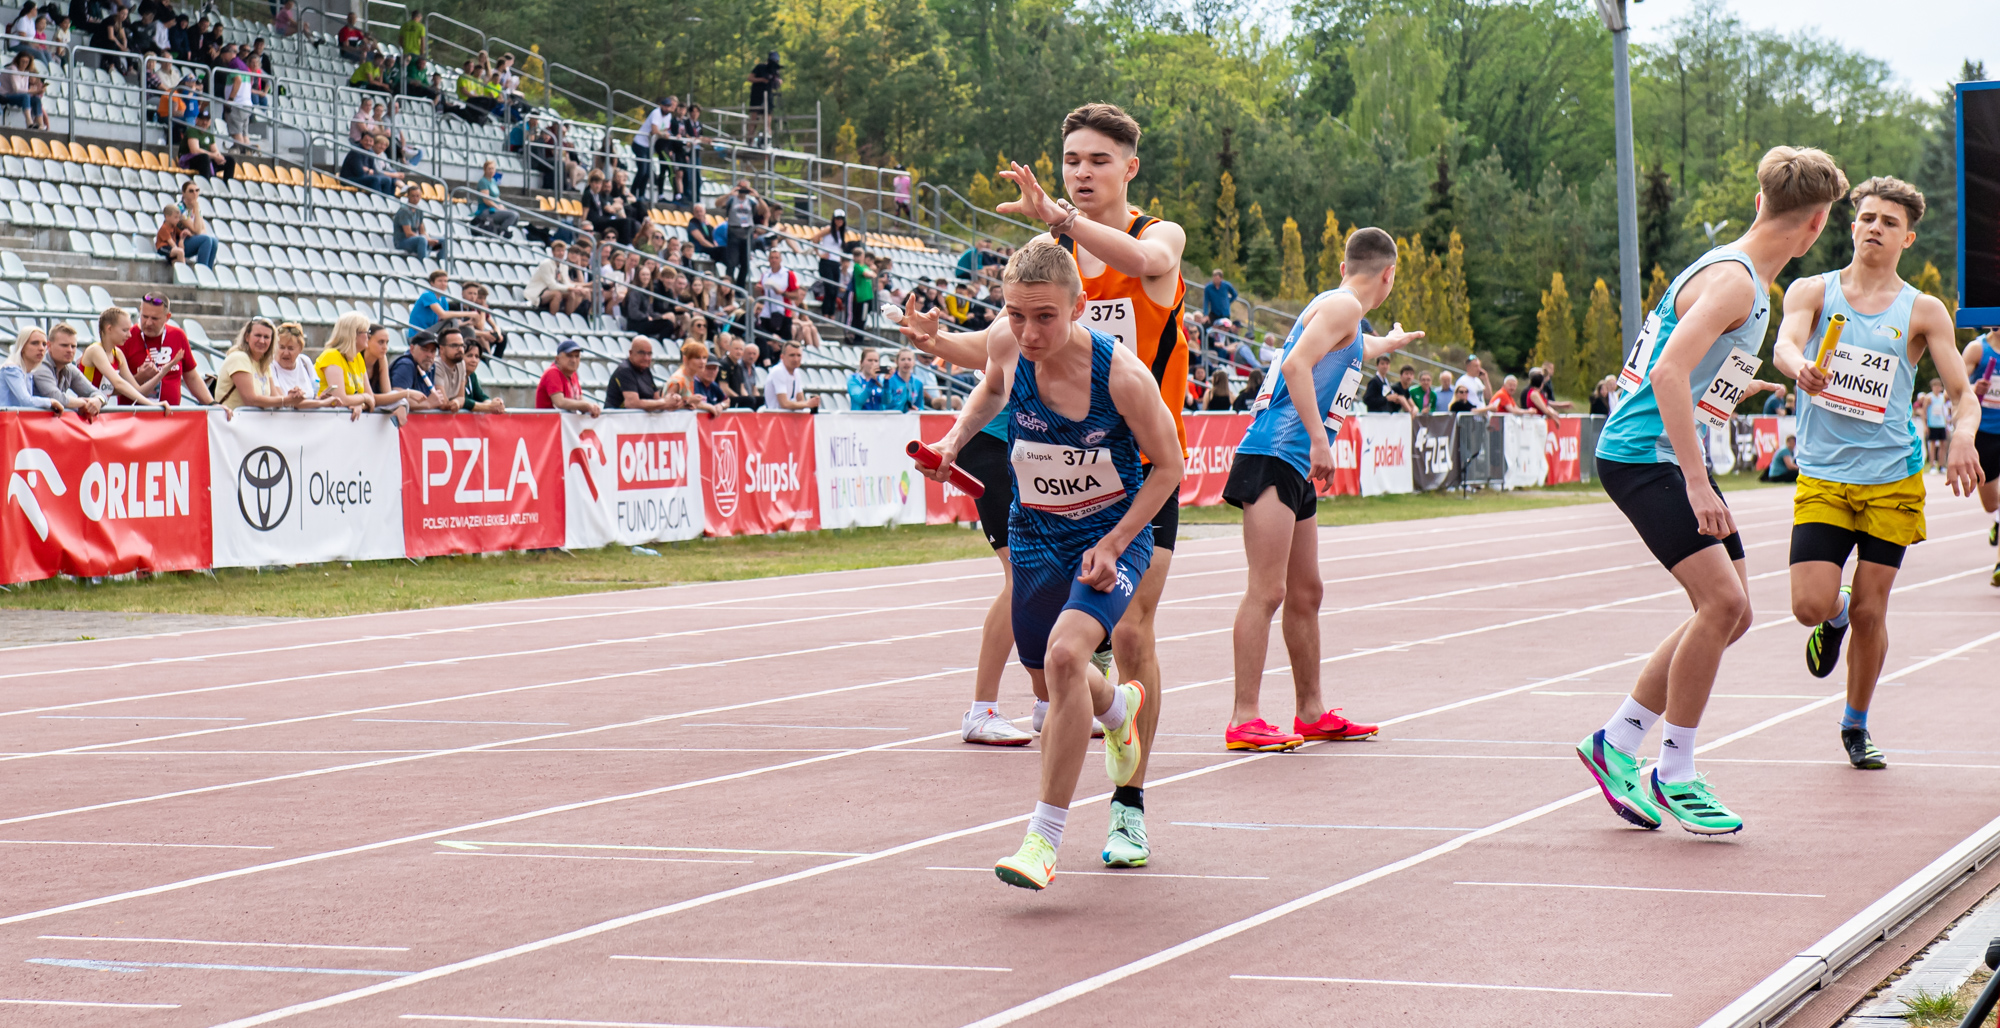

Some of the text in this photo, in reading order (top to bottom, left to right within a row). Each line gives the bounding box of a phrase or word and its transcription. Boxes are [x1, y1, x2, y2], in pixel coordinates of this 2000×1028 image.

[1091, 304, 1126, 321] 375
[1833, 349, 1853, 361] UEL
[1861, 353, 1890, 372] 241
[1832, 370, 1888, 399] MIŃSKI
[1825, 400, 1865, 416] SŁUPSK 2023
[619, 440, 686, 484] ORLEN
[1026, 449, 1100, 466] Słupsk 377
[1184, 446, 1207, 481] ZEK
[422, 437, 538, 505] PZLA
[745, 452, 800, 502] Słupsk
[79, 460, 190, 522] ORLEN
[309, 469, 372, 514] Okęcie
[1033, 474, 1102, 496] OSIKA
[1081, 504, 1102, 514] 2023
[422, 512, 539, 530] POLSKI ZWIĄZEK LEKKIEJ ATLETYKI
